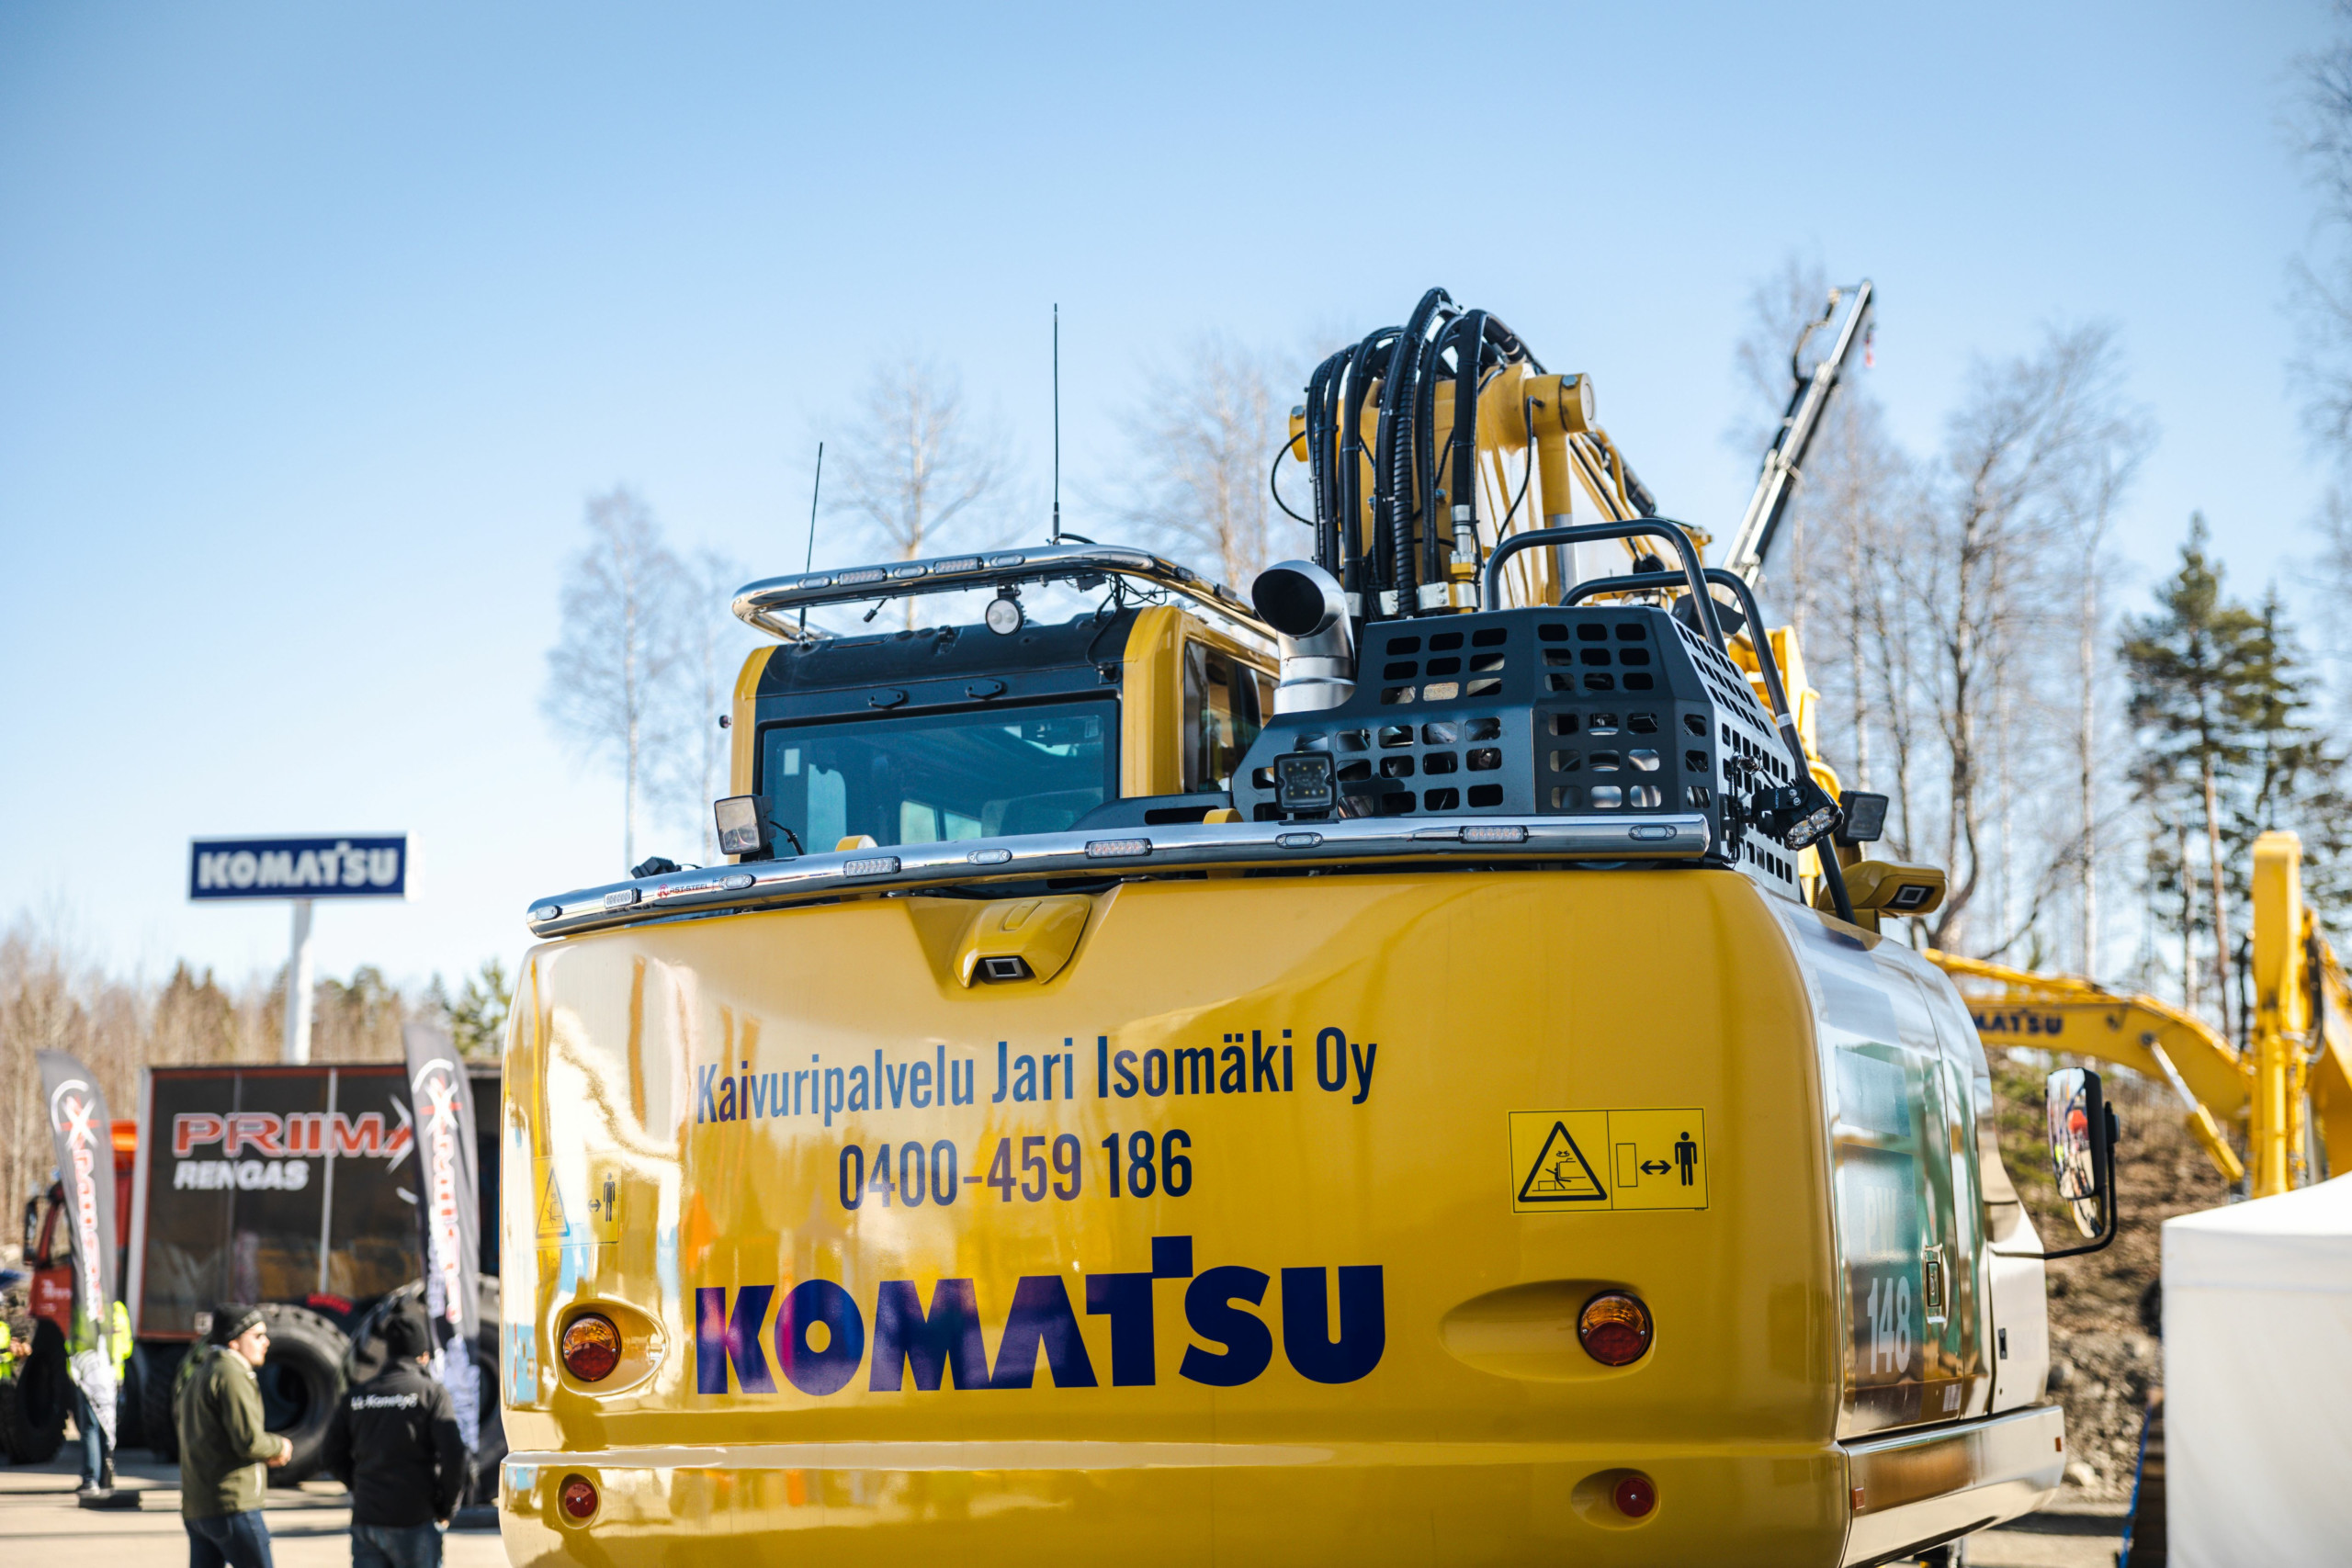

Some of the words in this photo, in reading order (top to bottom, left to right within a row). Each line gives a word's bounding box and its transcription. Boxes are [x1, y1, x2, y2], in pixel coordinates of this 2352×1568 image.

[198, 840, 399, 889] KOMATSU
[697, 1044, 974, 1127] Kaivuripalvelu
[991, 1037, 1073, 1102] Jari
[1097, 1029, 1294, 1099] Isomäki
[1316, 1026, 1377, 1104] Oy
[174, 1160, 310, 1191] RENGAS
[839, 1133, 1081, 1210] 0400-459
[1102, 1129, 1193, 1198] 186
[695, 1235, 1385, 1396] KOMATSU
[1867, 1276, 1911, 1375] 148
